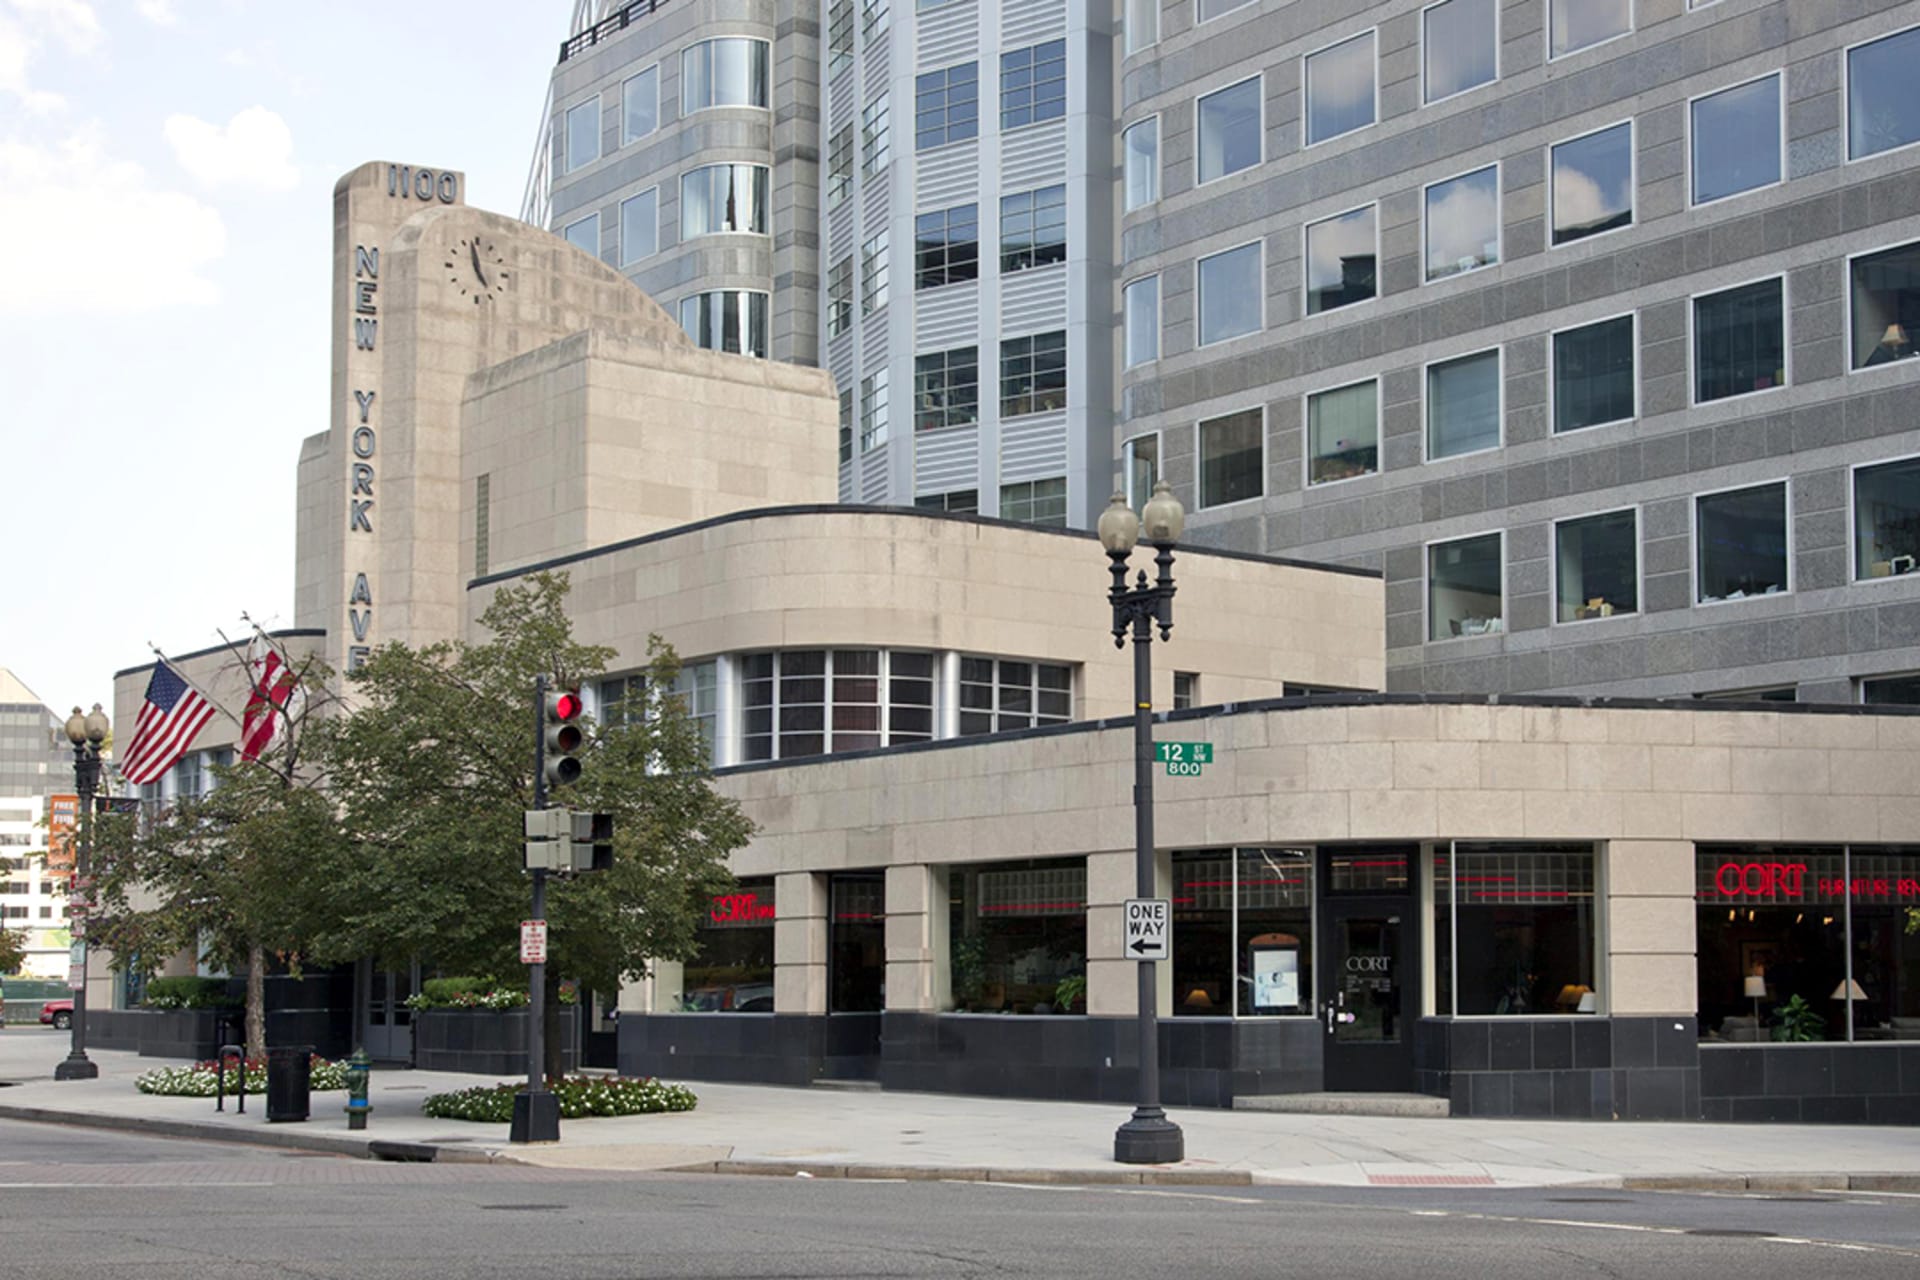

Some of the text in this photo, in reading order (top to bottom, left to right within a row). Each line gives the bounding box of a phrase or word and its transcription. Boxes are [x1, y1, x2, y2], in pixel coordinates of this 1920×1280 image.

[388, 164, 457, 204] 1100
[349, 245, 379, 672] NEW YORK AVE
[1161, 743, 1183, 761] 12
[1169, 762, 1200, 775] 800
[1715, 863, 1807, 897] CORT
[1130, 904, 1164, 920] ONE
[1129, 921, 1165, 936] WAY
[1346, 956, 1391, 971] CORT
